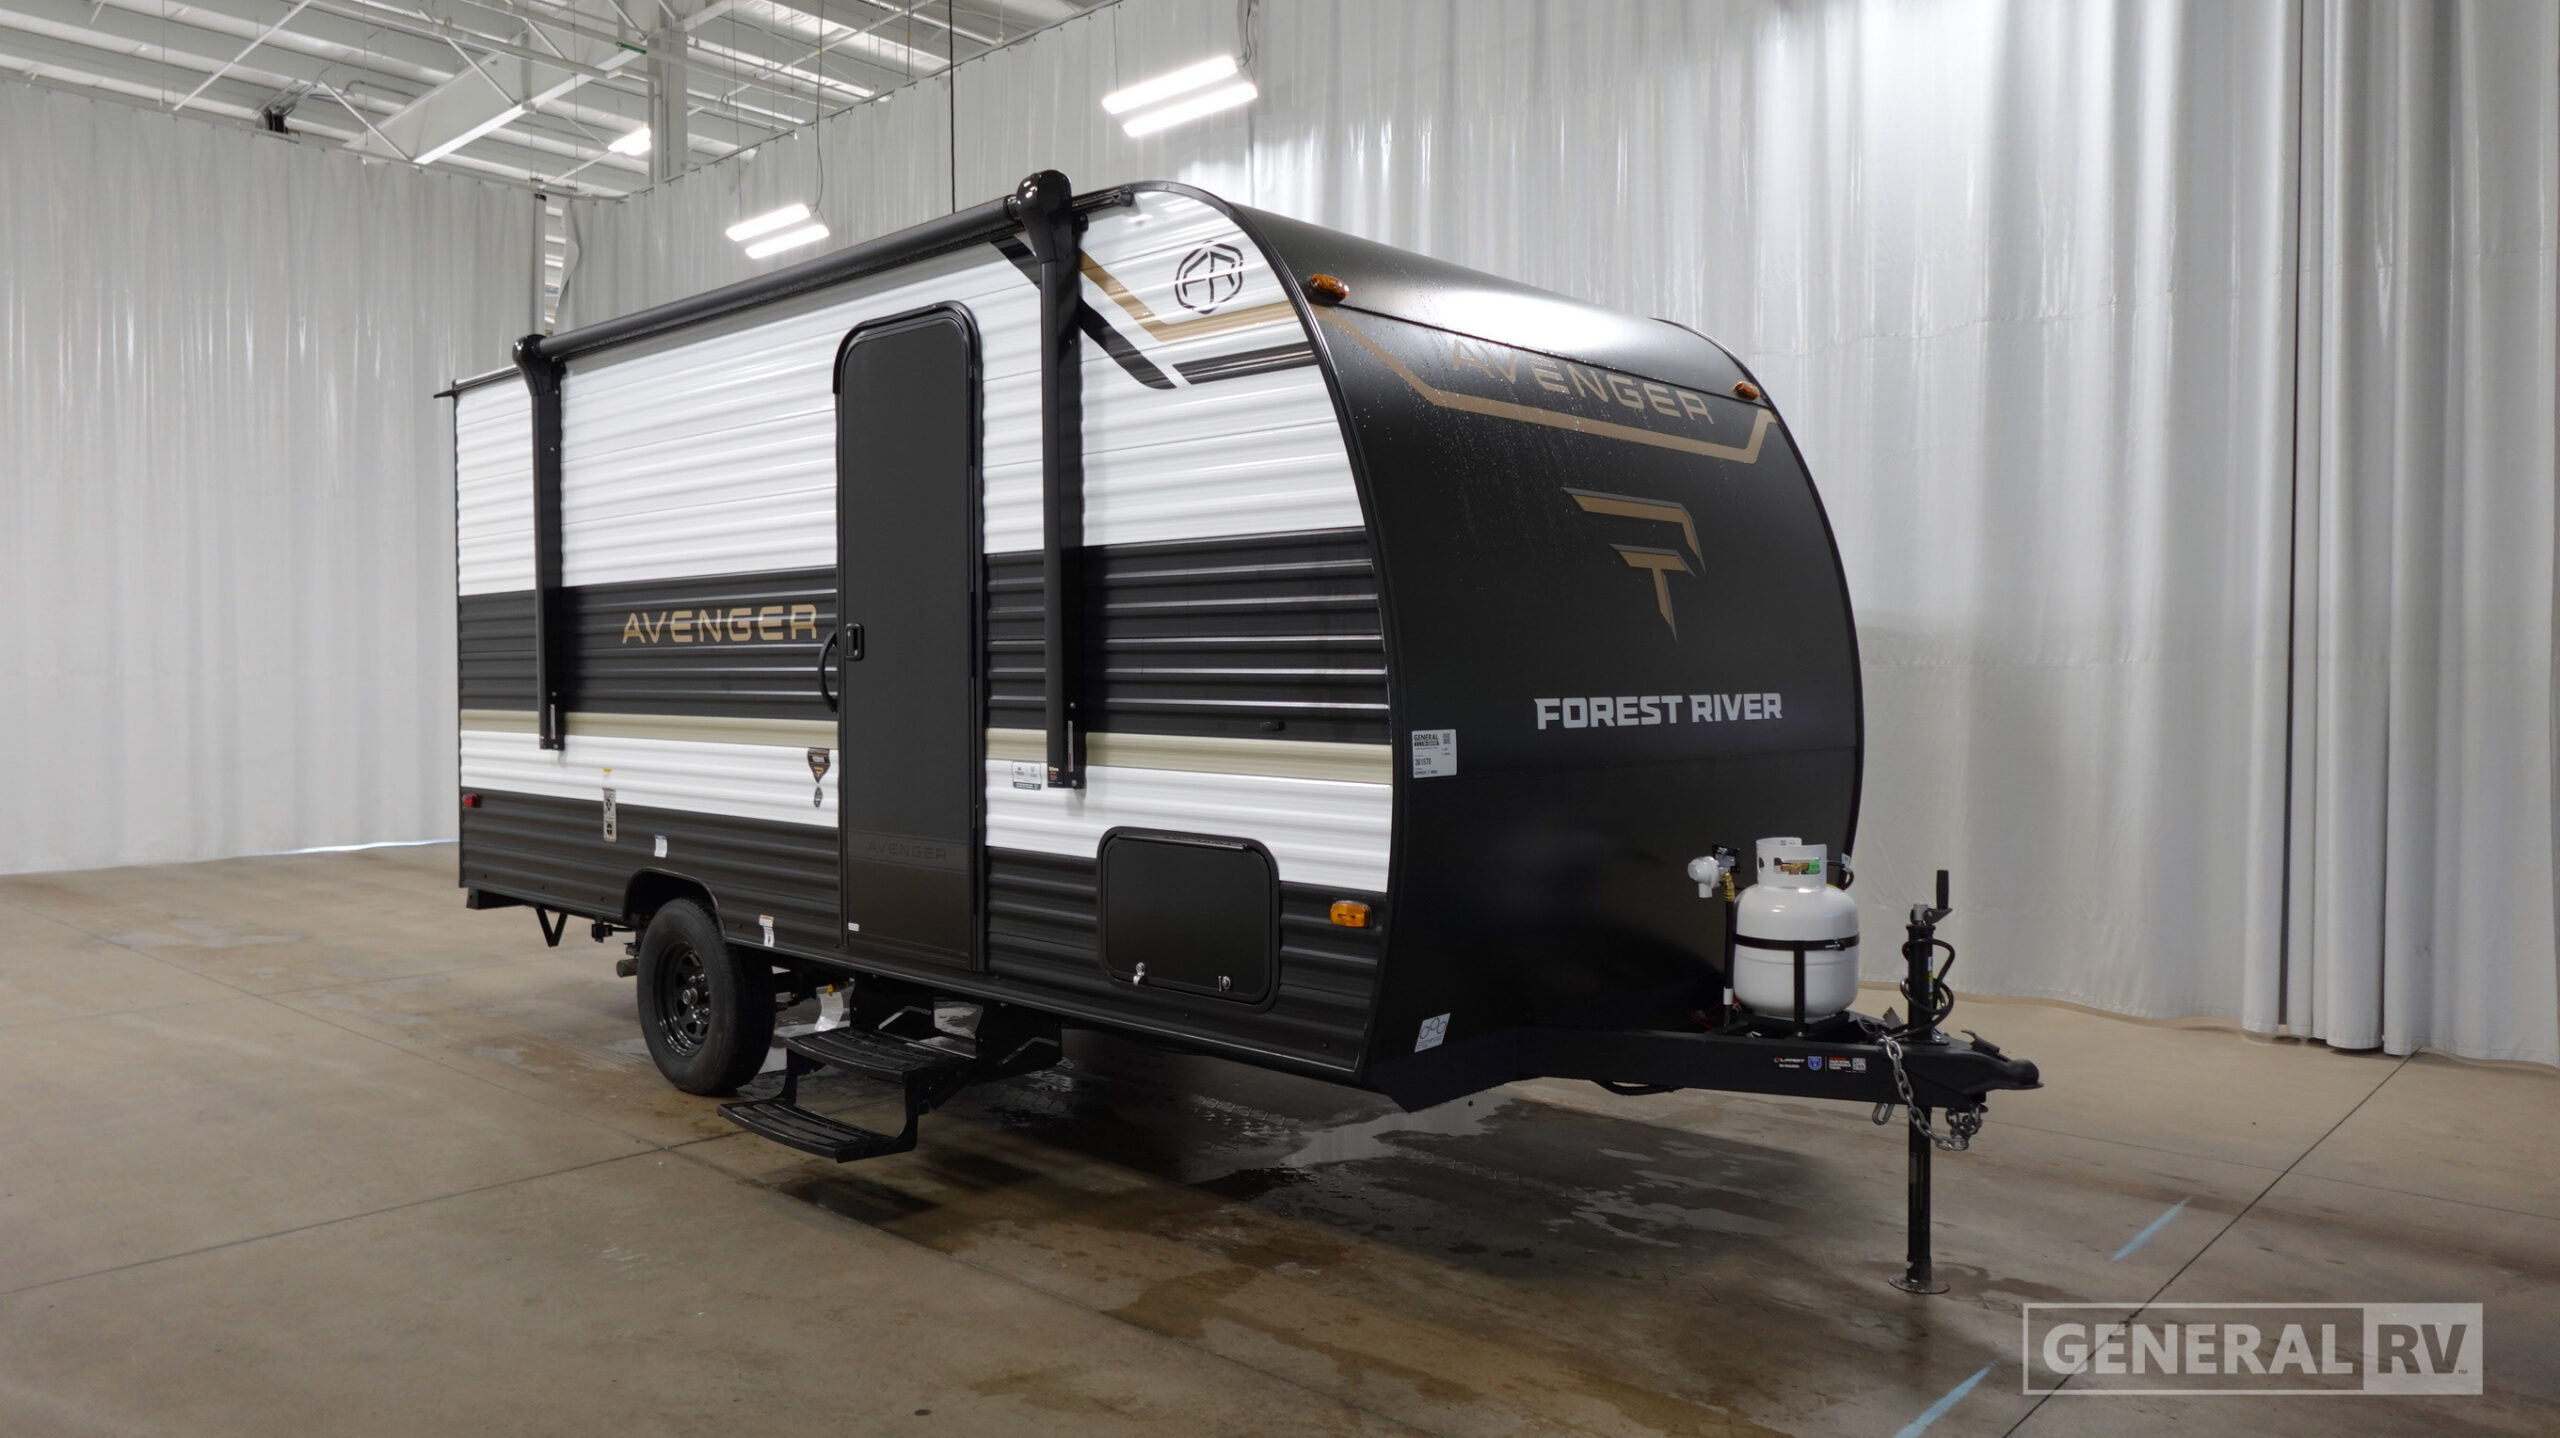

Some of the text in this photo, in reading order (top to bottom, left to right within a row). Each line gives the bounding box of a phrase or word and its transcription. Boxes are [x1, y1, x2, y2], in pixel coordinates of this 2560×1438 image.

[1452, 339, 1714, 424] AVENGER
[622, 604, 817, 644] AVENGER
[1534, 693, 1783, 730] FOREST RIVER
[1414, 733, 1439, 741] GENERAL
[866, 840, 947, 861] AVENGER
